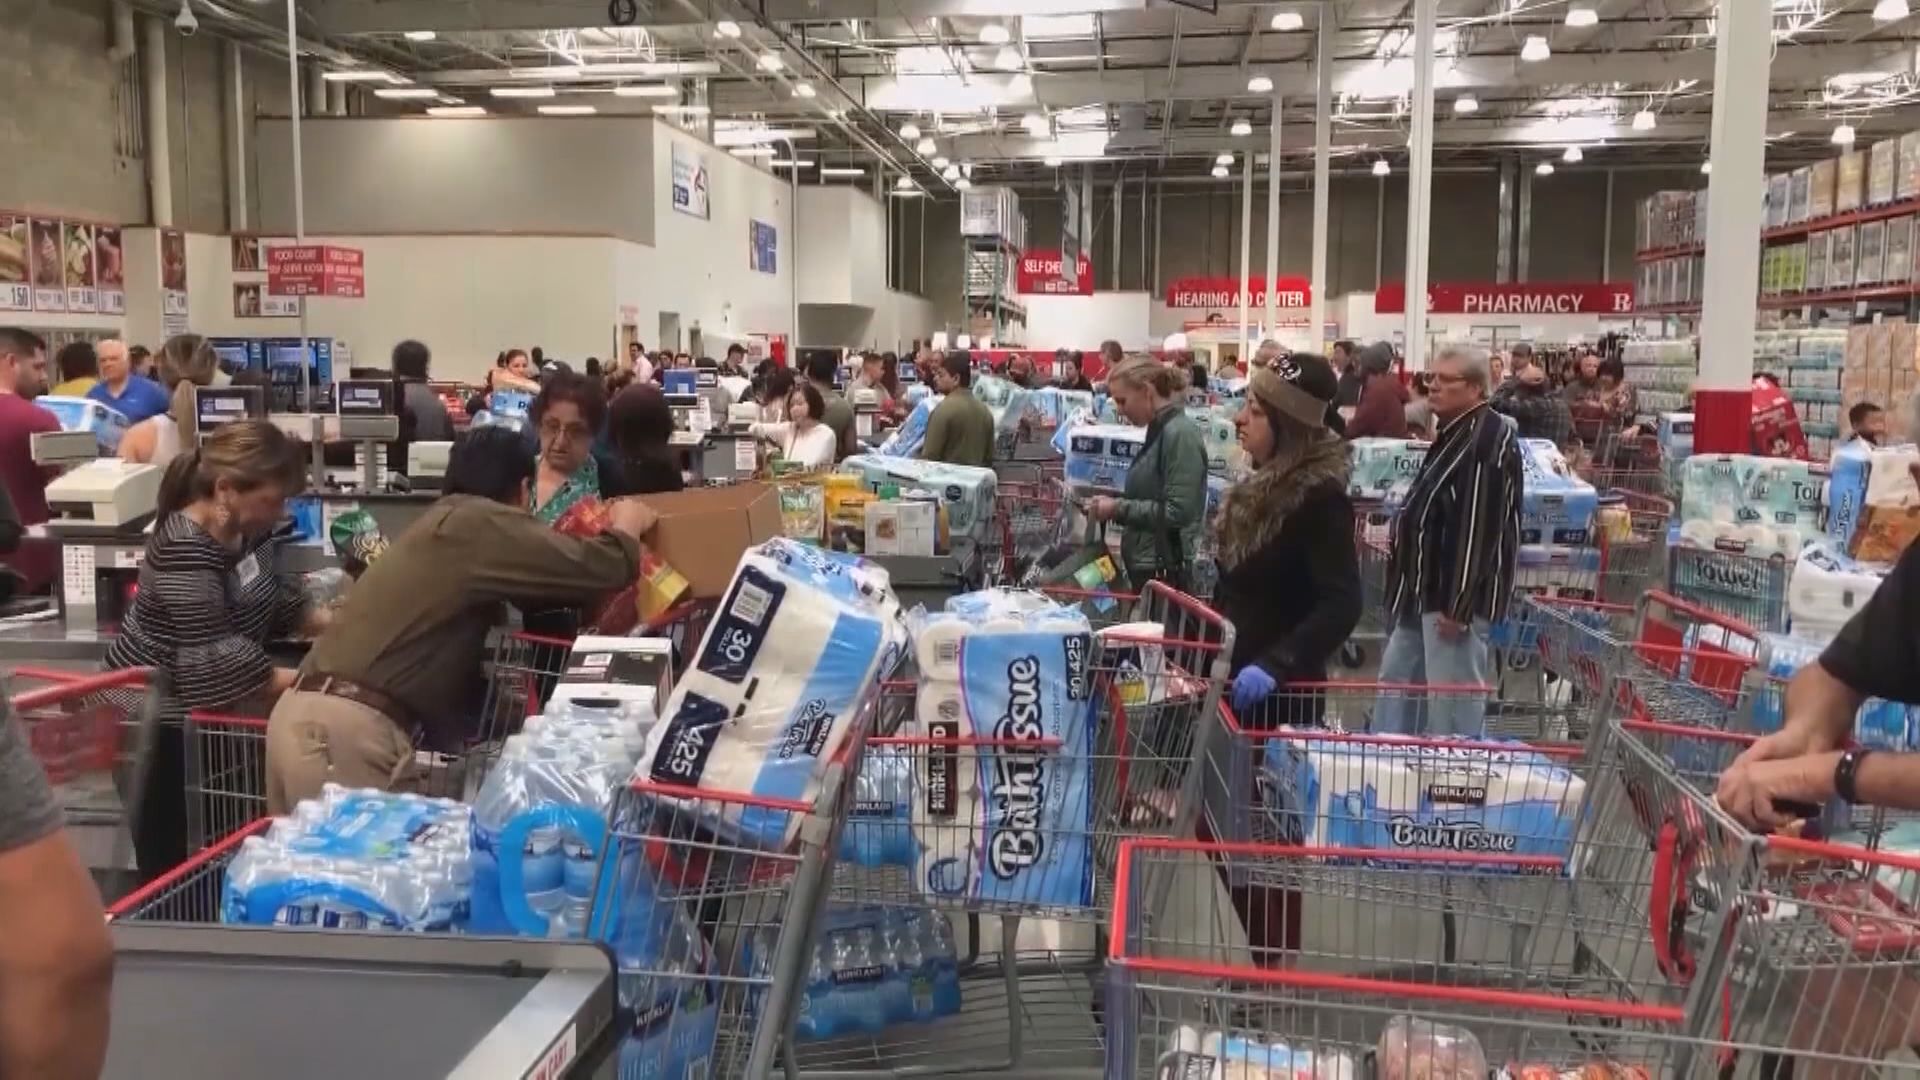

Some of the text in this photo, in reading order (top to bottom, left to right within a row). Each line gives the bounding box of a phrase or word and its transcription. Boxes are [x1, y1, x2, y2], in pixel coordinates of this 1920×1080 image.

[1024, 259, 1088, 275] SELF CHEUT
[1174, 290, 1304, 307] HEARING AD CTER
[1463, 294, 1584, 313] PHARMACY
[724, 628, 753, 663] 30
[1067, 635, 1083, 673] 425
[990, 655, 1046, 766] Tssue
[671, 726, 704, 777] 425
[931, 725, 946, 809] KIRKLD
